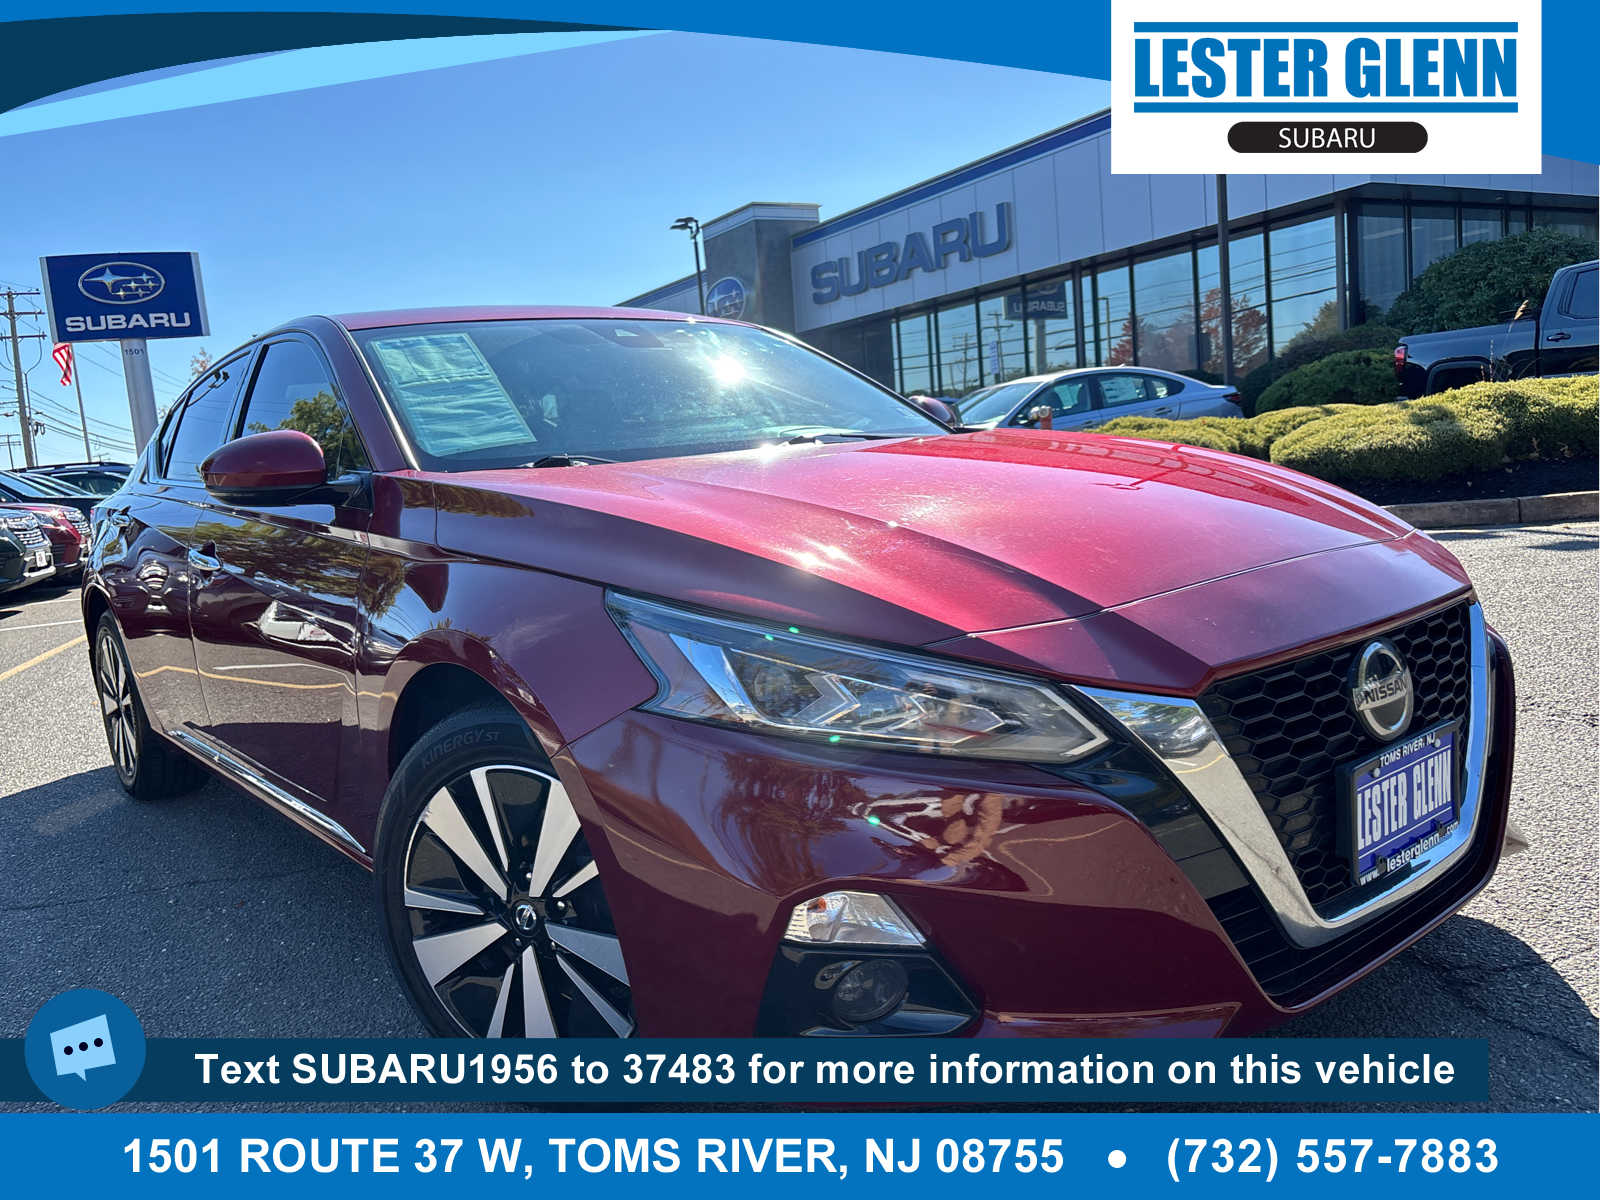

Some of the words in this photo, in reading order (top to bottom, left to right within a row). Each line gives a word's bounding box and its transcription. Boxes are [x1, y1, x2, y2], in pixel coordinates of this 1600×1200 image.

[811, 202, 1011, 305] SUBARU
[65, 312, 191, 332] SUBARU
[1363, 679, 1407, 704] NISSAN
[1380, 749, 1401, 767] TOMS
[1426, 731, 1436, 746] NJ
[1357, 772, 1408, 850] LESTER
[1413, 751, 1451, 820] GLENN
